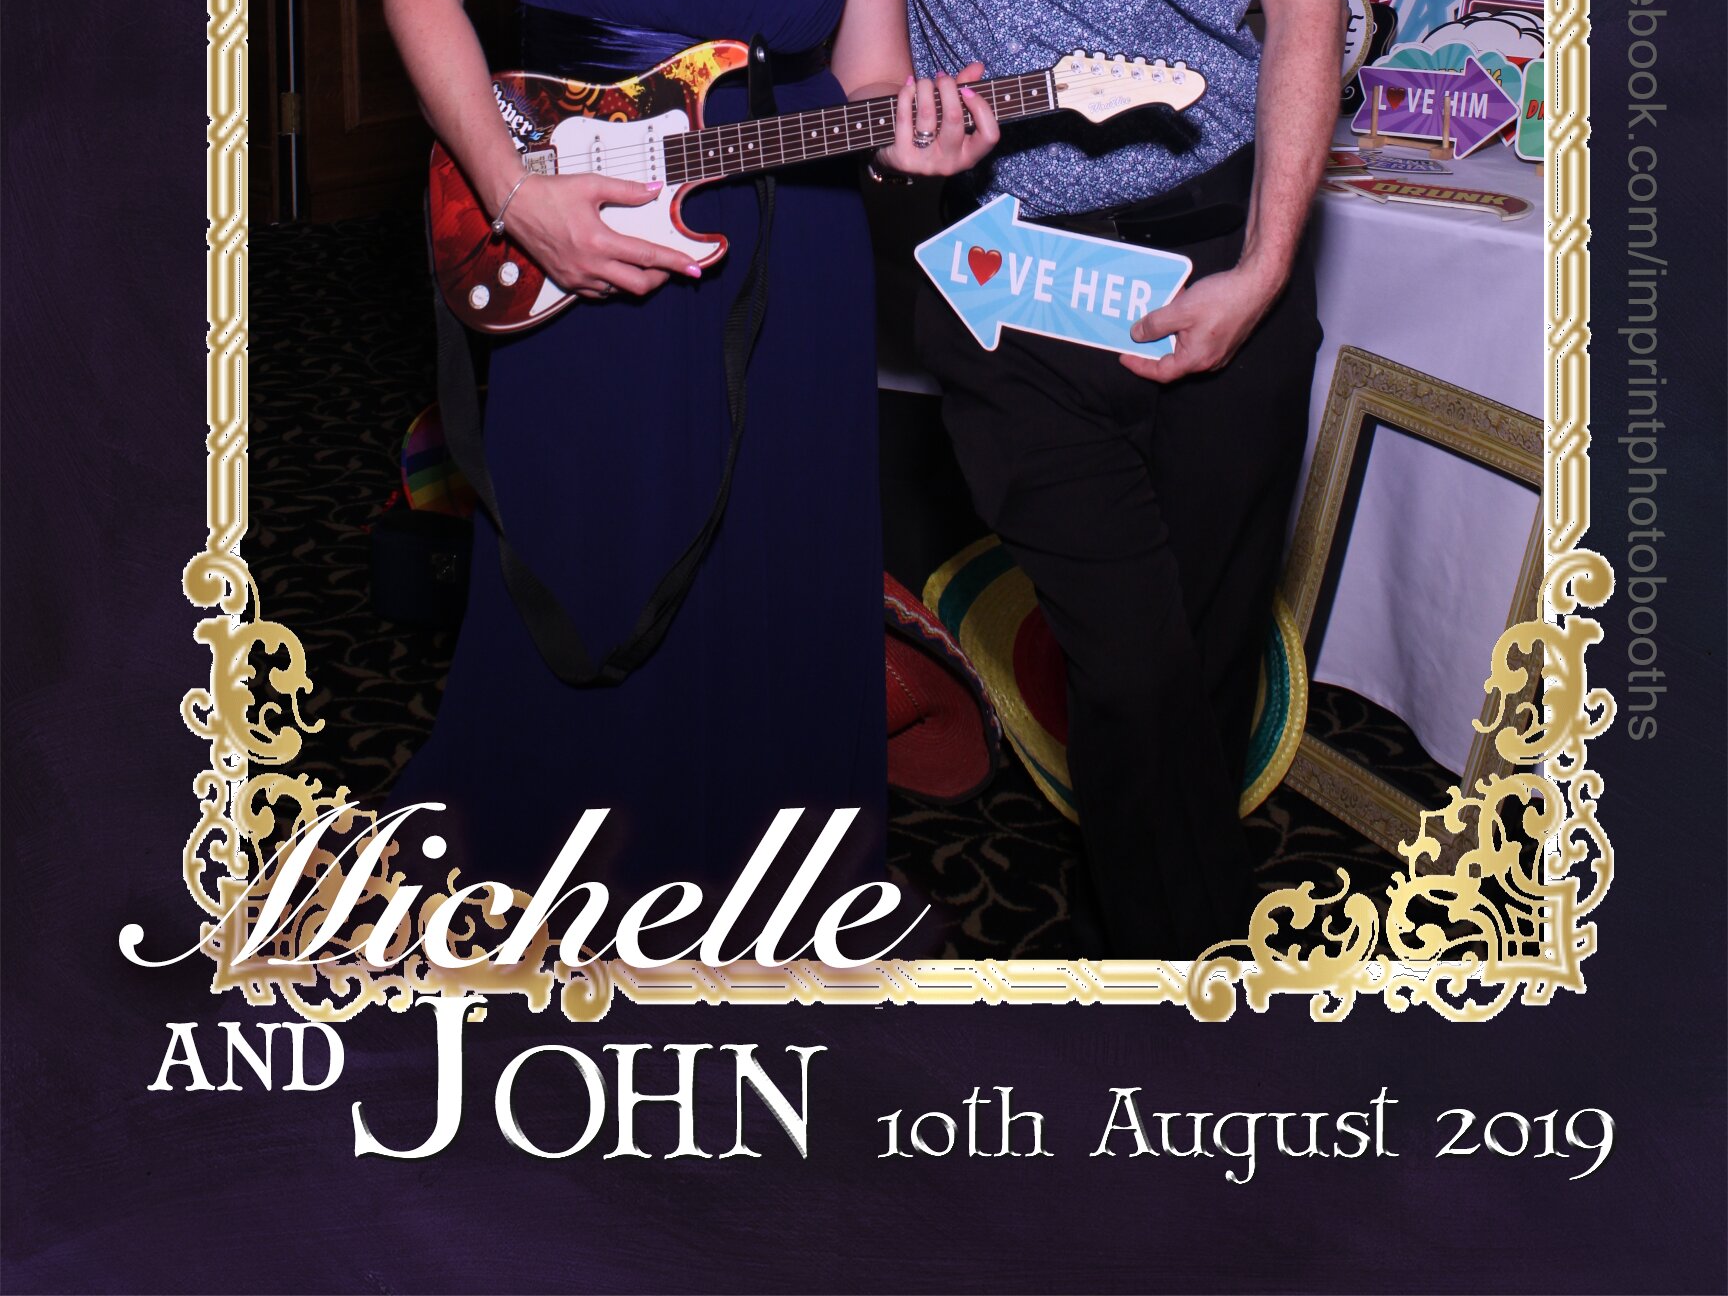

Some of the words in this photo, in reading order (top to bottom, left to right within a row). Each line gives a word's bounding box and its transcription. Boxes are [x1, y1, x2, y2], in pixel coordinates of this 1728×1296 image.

[1442, 91, 1489, 120] HIM
[1371, 181, 1510, 206] DRUNK
[1070, 266, 1152, 321] HER
